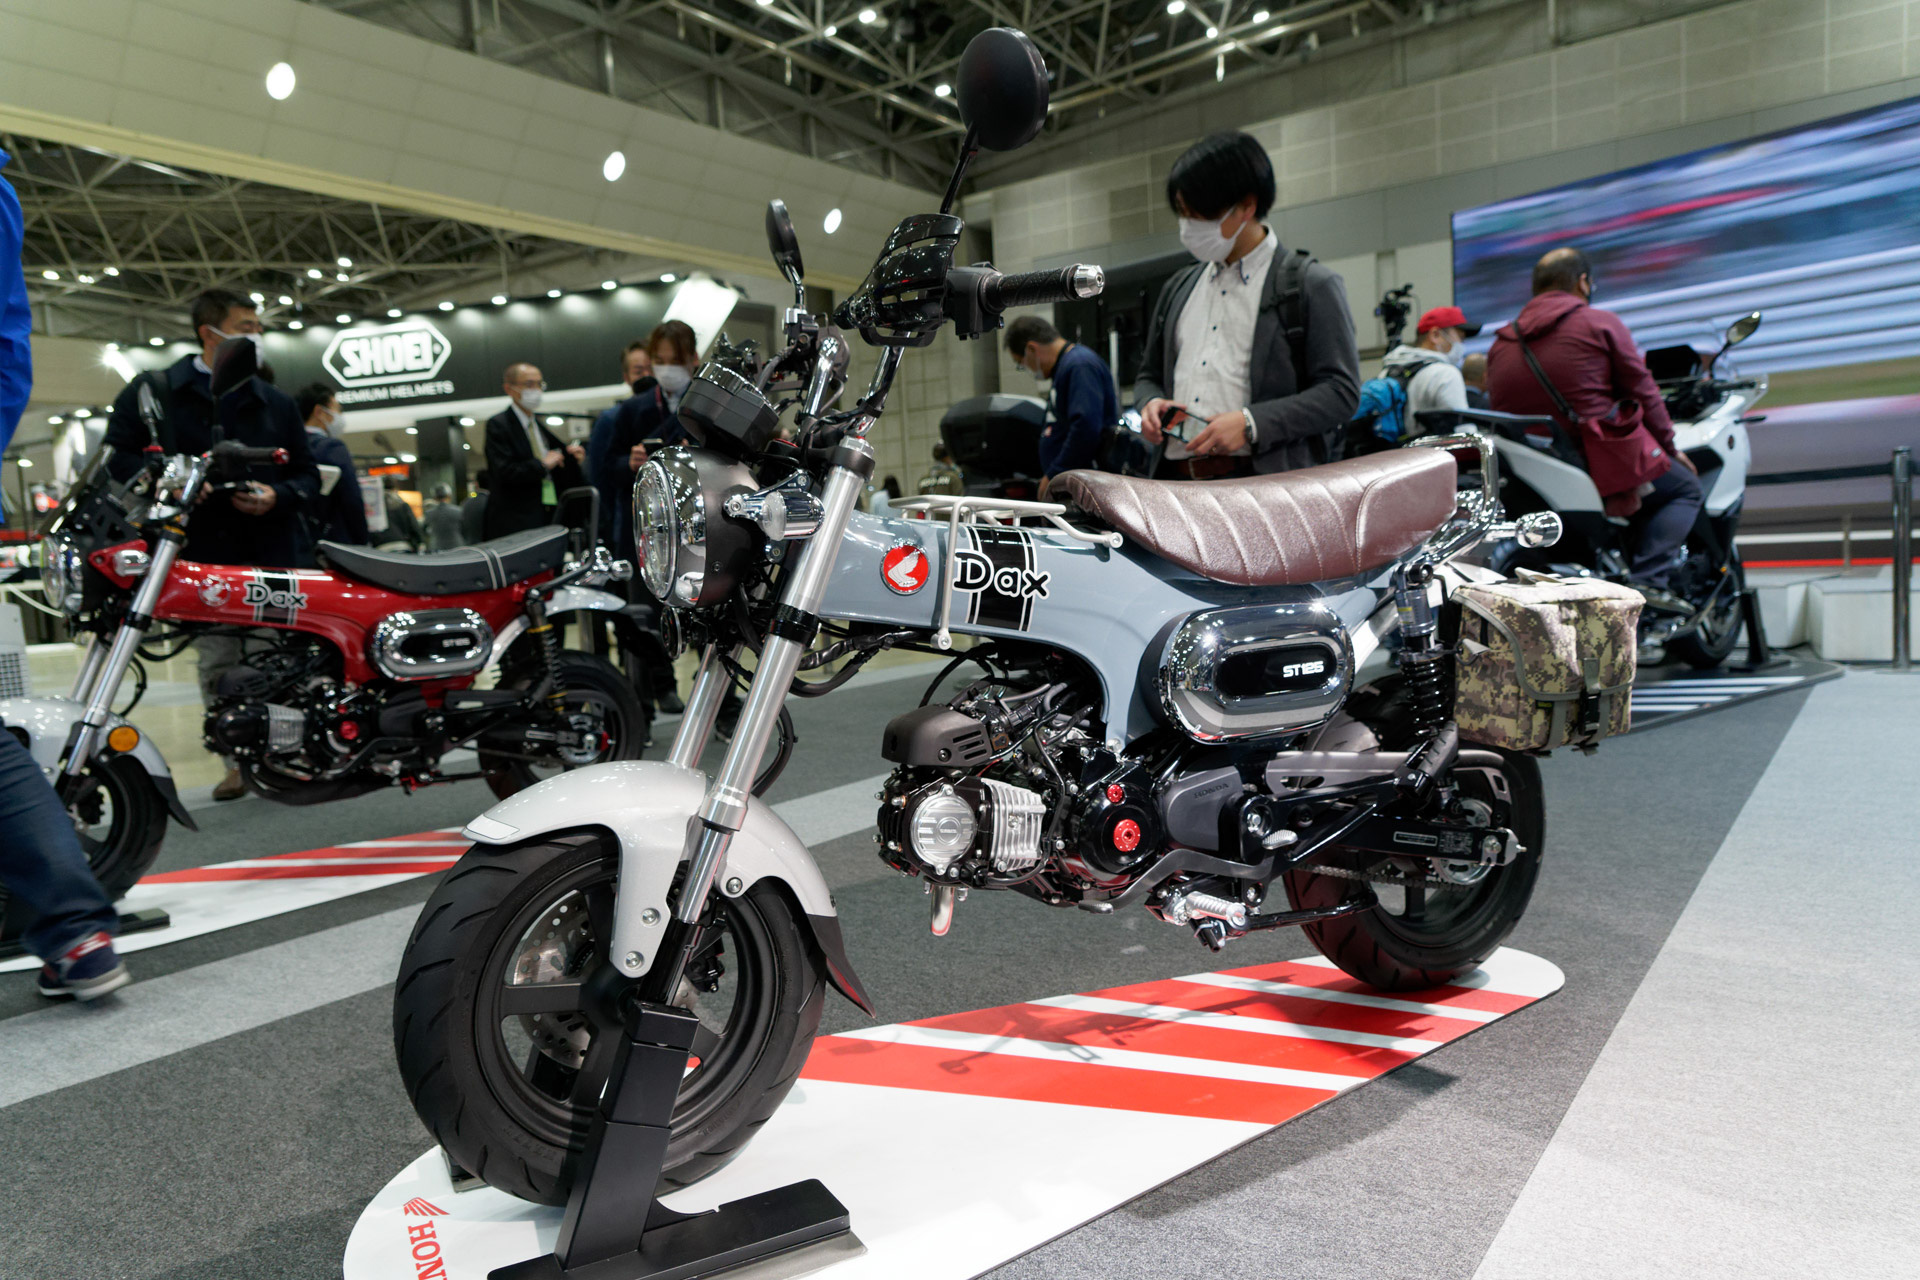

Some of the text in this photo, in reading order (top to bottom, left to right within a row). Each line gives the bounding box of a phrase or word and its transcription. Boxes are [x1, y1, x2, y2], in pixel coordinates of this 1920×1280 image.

[340, 331, 434, 378] SHOEI
[335, 380, 455, 404] REMIUM HELMETS
[953, 549, 1051, 599] Dax
[242, 581, 308, 609] Dax
[1283, 660, 1324, 678] ST125
[1193, 783, 1229, 799] HONDA
[408, 1220, 447, 1280] HON
